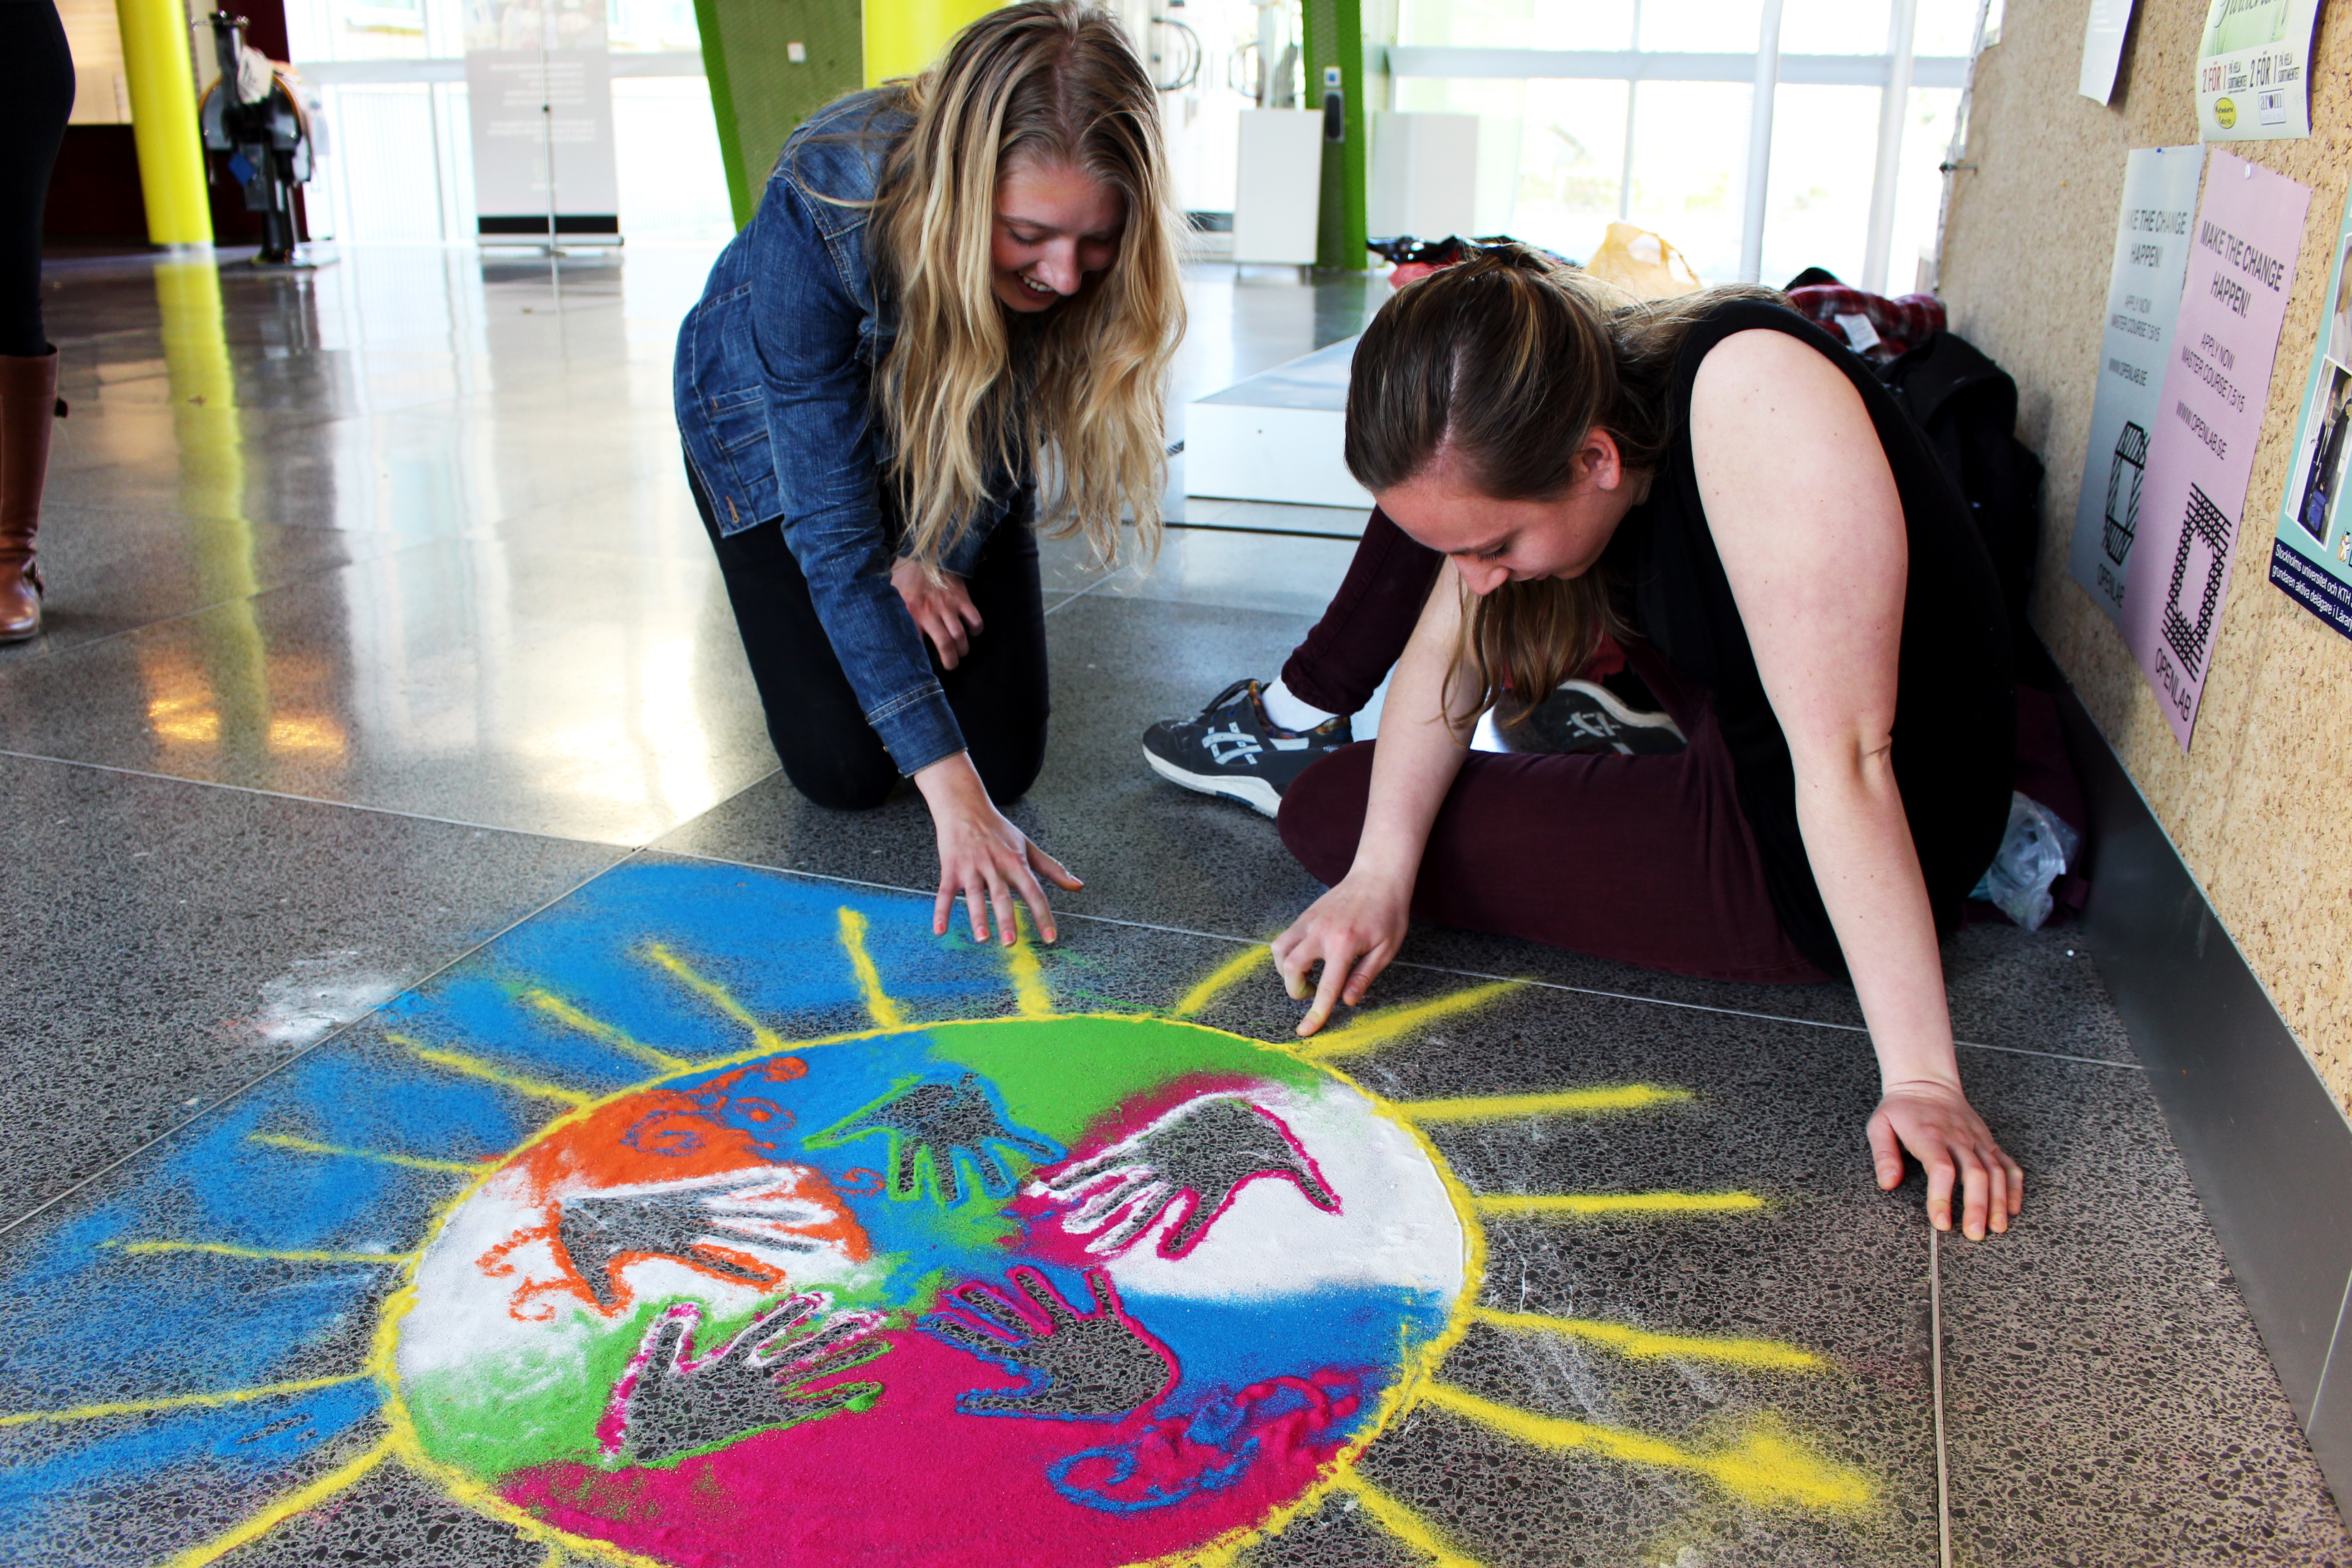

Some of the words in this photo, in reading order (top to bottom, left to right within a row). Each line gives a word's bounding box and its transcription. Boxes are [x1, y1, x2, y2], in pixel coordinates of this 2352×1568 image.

[2202, 69, 2207, 93] 2
[2209, 61, 2221, 92] FÖR
[2223, 65, 2227, 90] 1
[2249, 59, 2255, 88] 2
[2256, 50, 2271, 87] FÖR
[2274, 54, 2278, 83] 1
[2260, 93, 2282, 110] arom
[2140, 210, 2156, 231] THE
[2156, 211, 2187, 235] CHANGE
[2130, 243, 2163, 268] HAPPEN!
[2200, 220, 2226, 255] MAKE
[2225, 234, 2244, 267] THE
[2243, 245, 2284, 292] CHANGE
[2125, 294, 2139, 310] APPLY
[2210, 271, 2251, 318] HAPPEN!
[2200, 333, 2220, 358] APPLY
[2219, 345, 2235, 371] NOW
[2181, 345, 2204, 377] MASTER
[2203, 364, 2228, 397] COURSE
[2227, 384, 2245, 413] 7,5/15
[2176, 399, 2227, 461] WWW.OPENLAB.SE
[2275, 544, 2302, 573] Stockholms
[2302, 563, 2328, 590] universitet
[2327, 581, 2337, 597] och
[2337, 585, 2352, 606] KTH
[2272, 565, 2295, 589] grundaren
[2295, 580, 2309, 599] aktiva
[2310, 590, 2332, 615] delägare
[2332, 604, 2336, 617] i
[2335, 606, 2352, 632] Lärarj
[2156, 647, 2191, 722] OPENLAB
